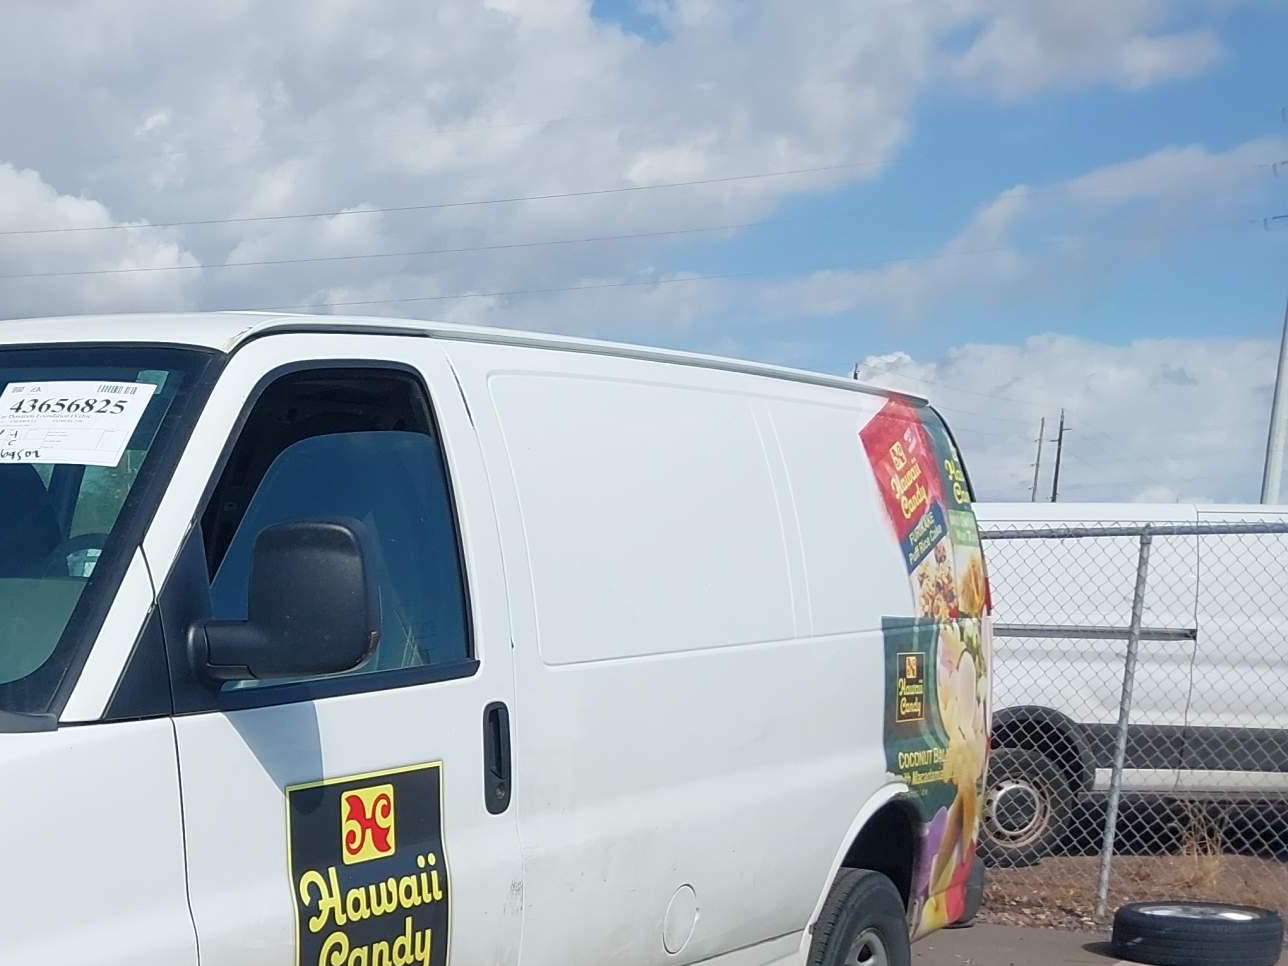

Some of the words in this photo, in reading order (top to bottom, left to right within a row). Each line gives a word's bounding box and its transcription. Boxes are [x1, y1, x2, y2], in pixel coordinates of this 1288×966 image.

[10, 398, 128, 414] 43656825
[891, 458, 922, 499] Hawaii
[901, 483, 929, 519] Candy
[898, 678, 923, 696] Hawaii
[900, 697, 921, 716] Candy
[898, 750, 933, 769] COCONUT
[300, 852, 443, 933] Hawaii
